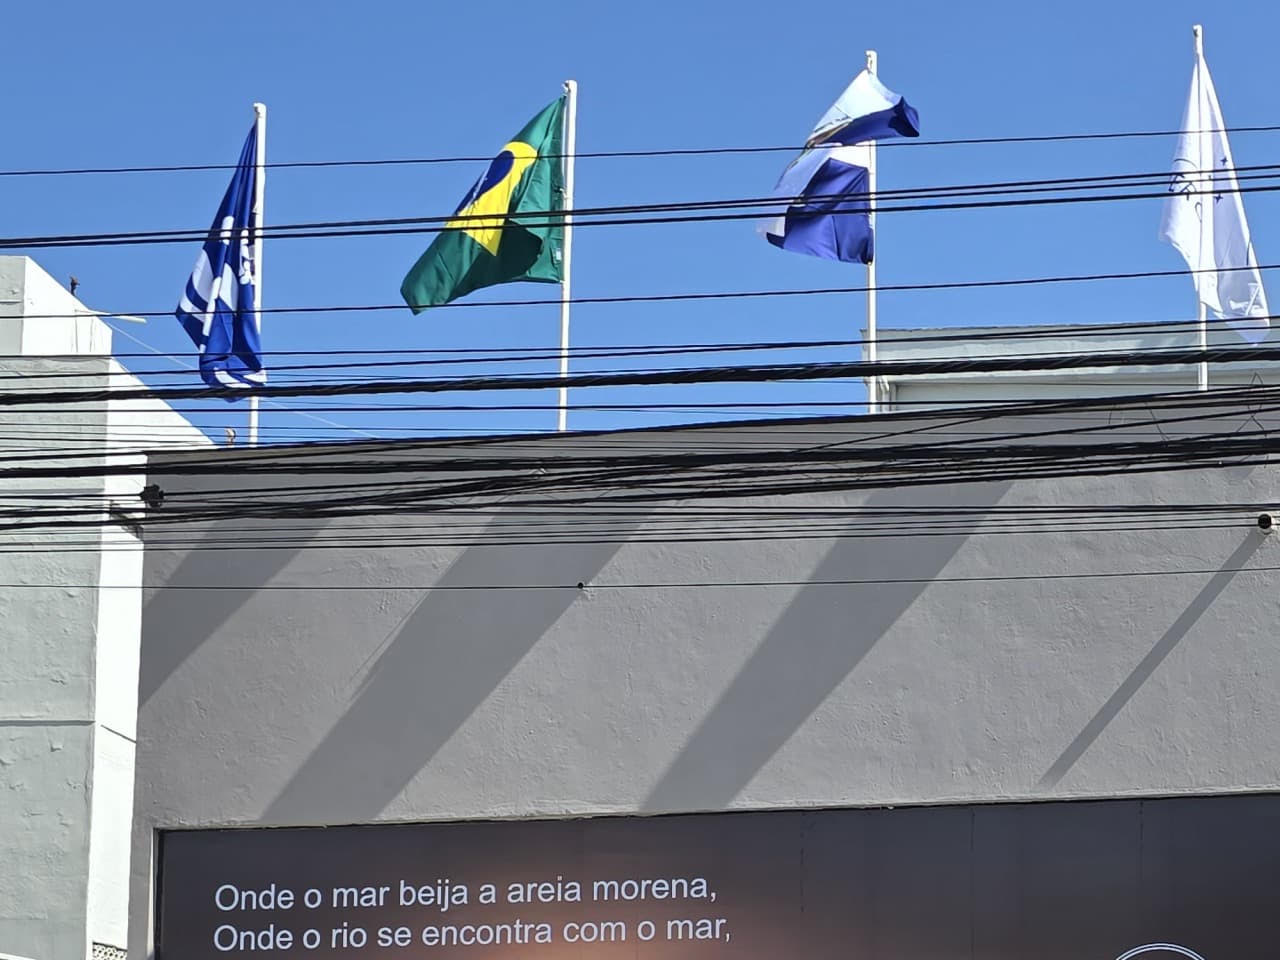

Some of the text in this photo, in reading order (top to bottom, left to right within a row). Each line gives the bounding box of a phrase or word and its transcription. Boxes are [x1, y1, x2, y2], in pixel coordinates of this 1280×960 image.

[215, 876, 715, 911] Onde o mar beija a areia morena,
[214, 919, 729, 951] Onde o rio se encontra com o mar,
